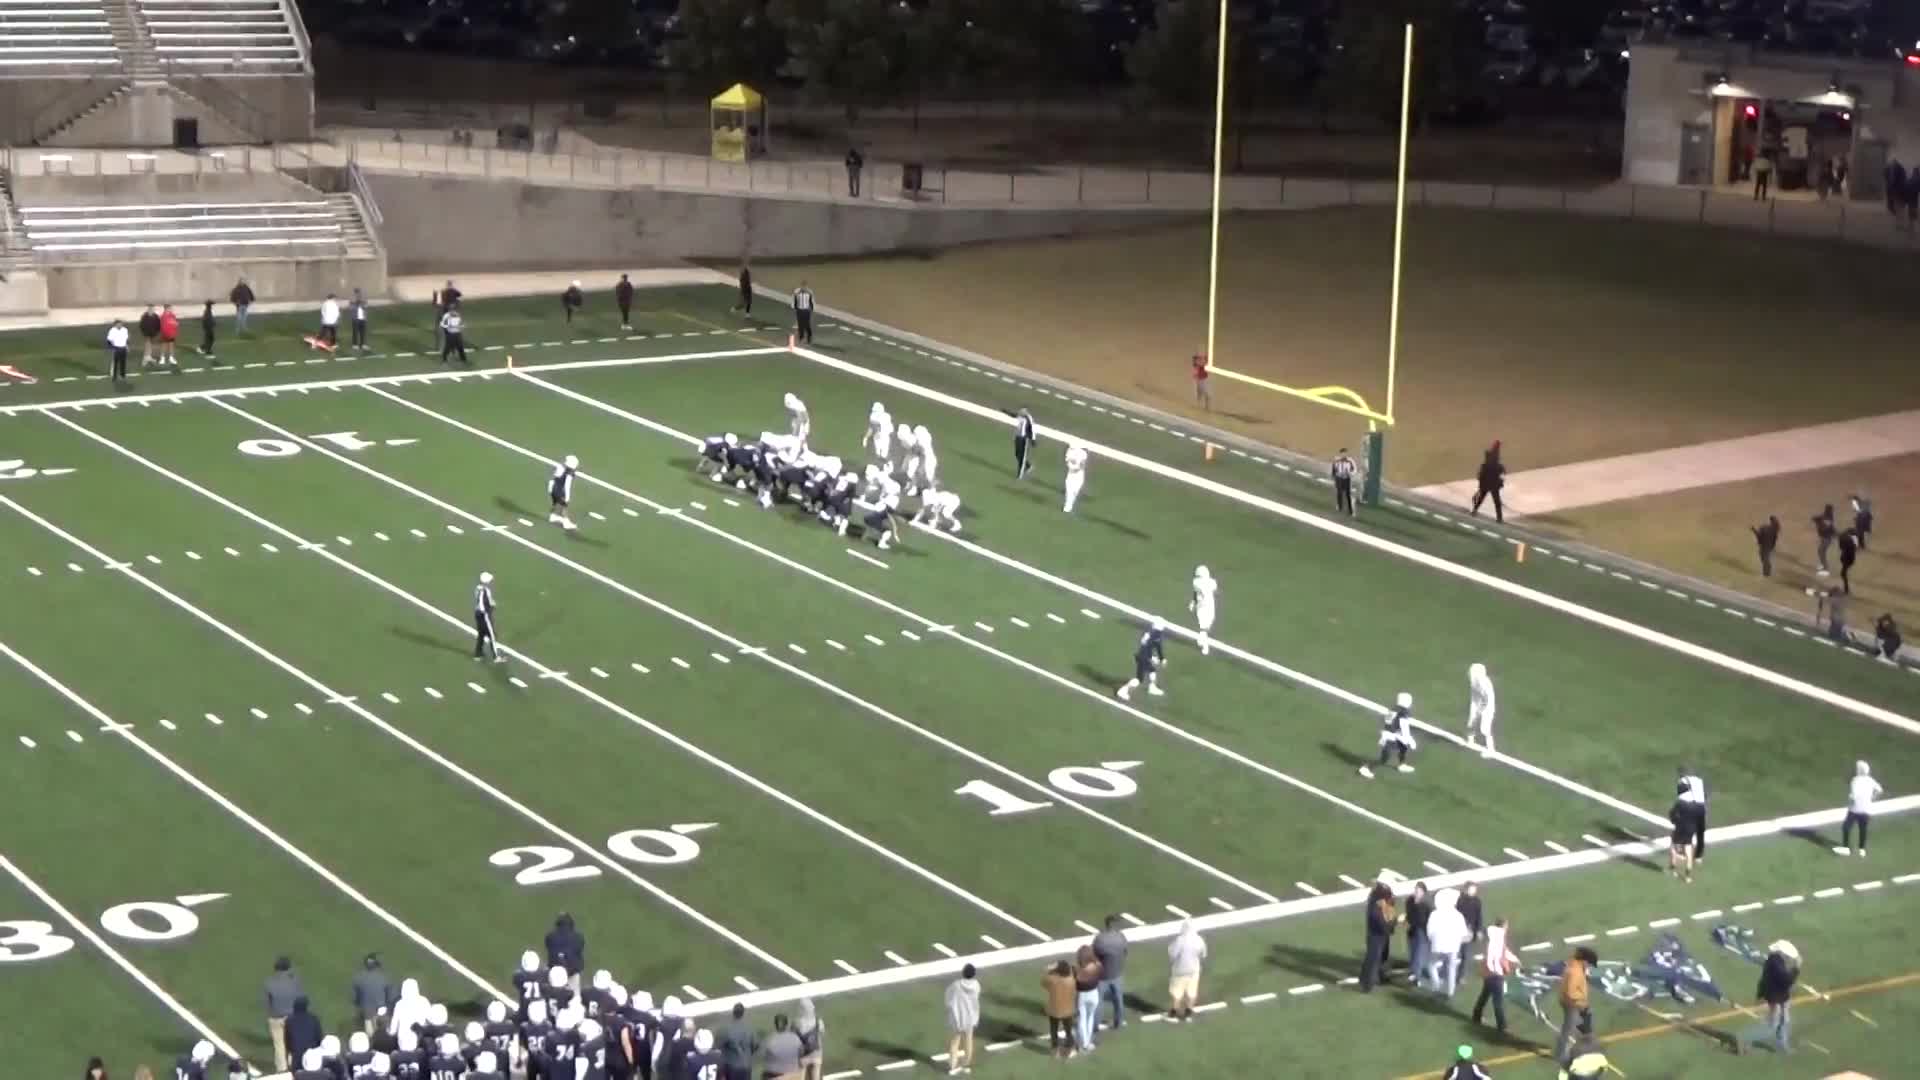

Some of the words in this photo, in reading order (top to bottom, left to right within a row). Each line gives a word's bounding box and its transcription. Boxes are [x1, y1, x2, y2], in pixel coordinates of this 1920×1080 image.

[954, 767, 1137, 815] 10
[489, 829, 700, 886] 20
[0, 902, 199, 961] 30
[522, 981, 540, 998] 71
